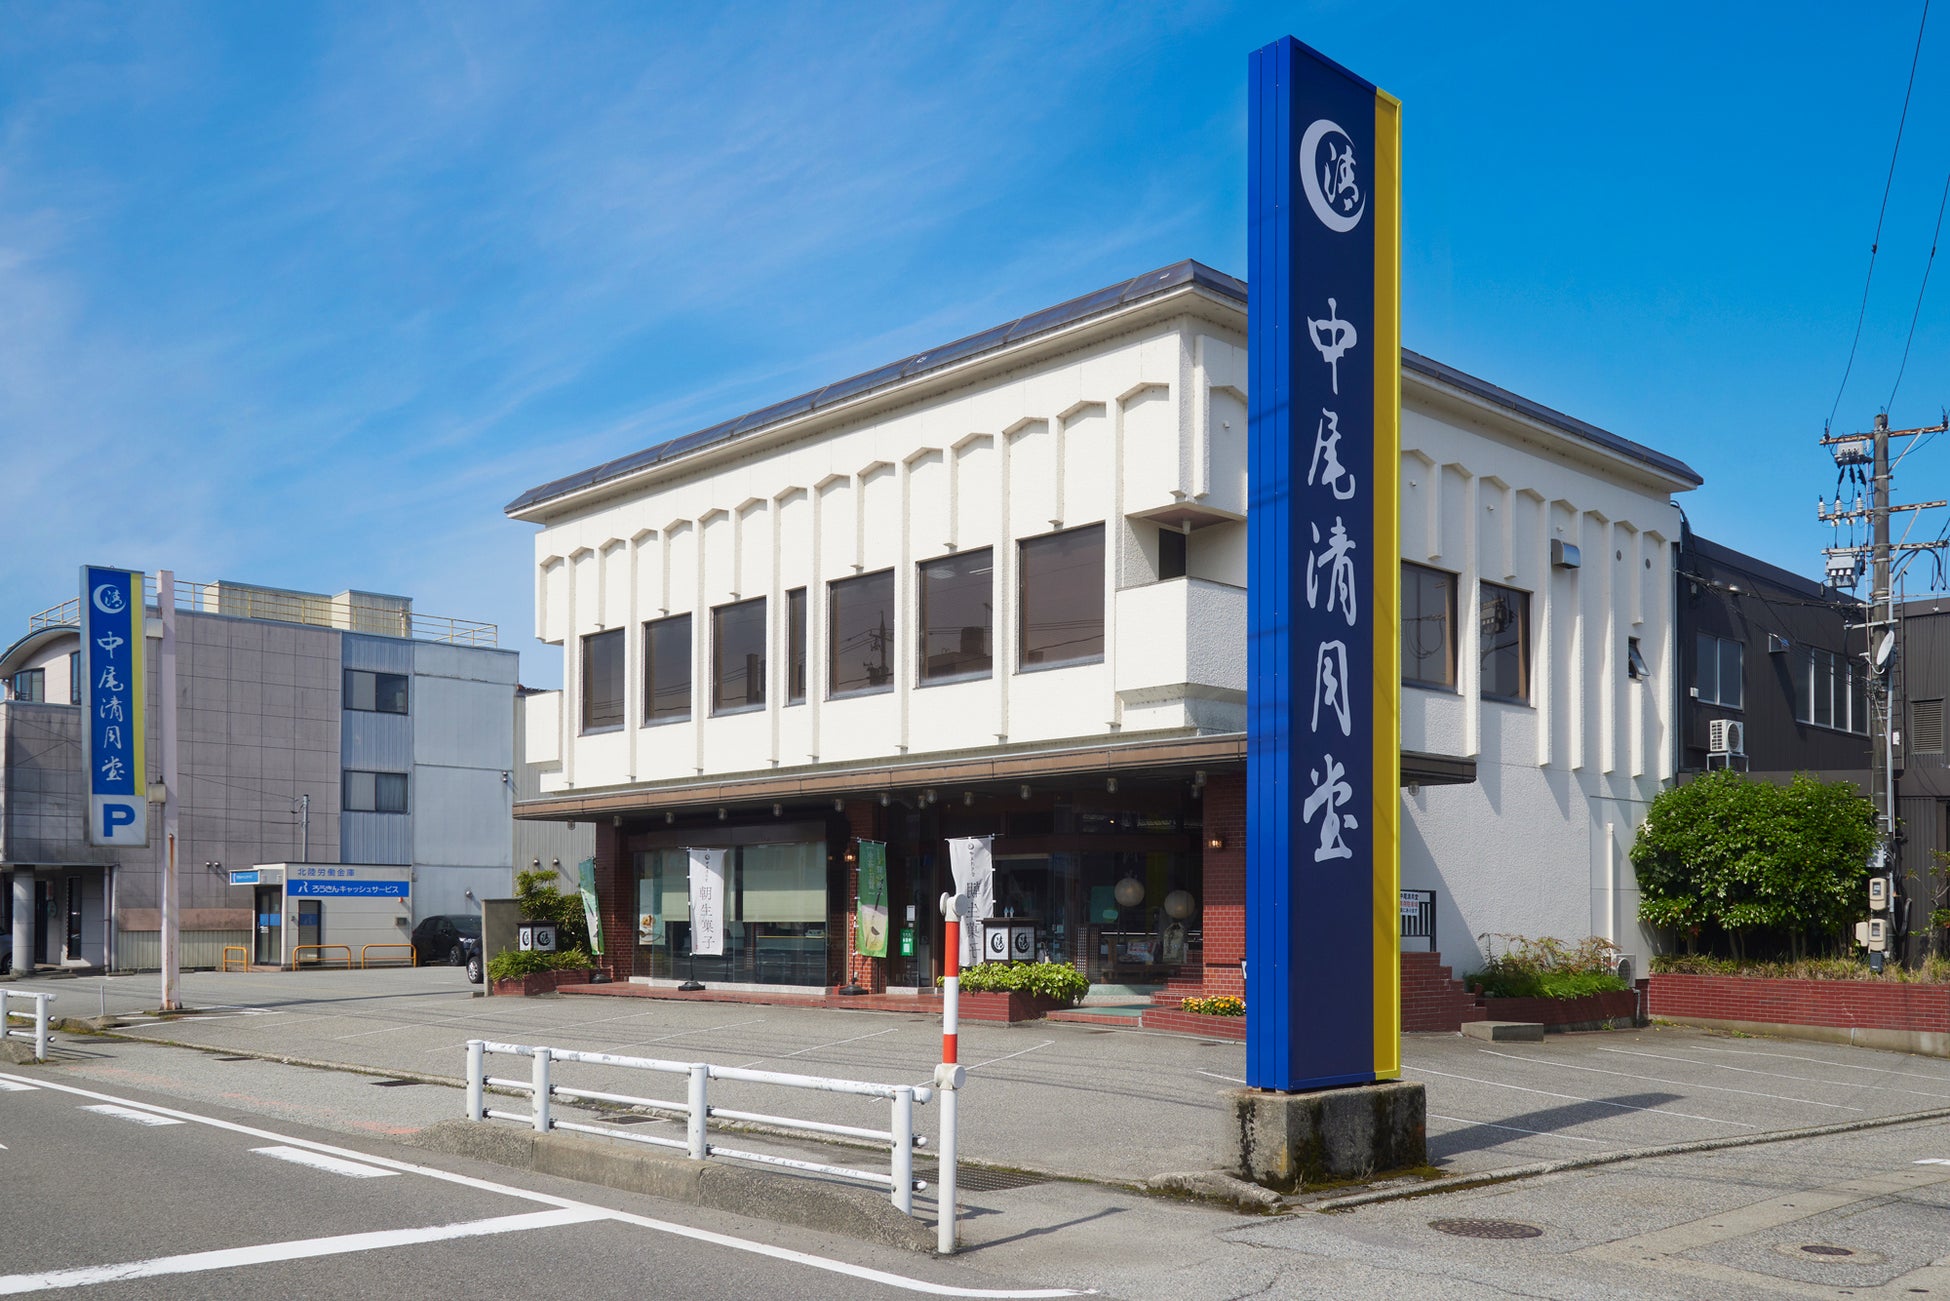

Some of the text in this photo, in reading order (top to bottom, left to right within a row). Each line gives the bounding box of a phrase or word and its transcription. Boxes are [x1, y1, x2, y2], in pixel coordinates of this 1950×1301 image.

[1303, 297, 1358, 862] 中尾清月堂
[97, 631, 125, 781] 中尾清月堂
[103, 803, 135, 837] P
[298, 867, 355, 877] 北陸労働金庫
[312, 884, 399, 894] ろうきんキャッシュサービス
[699, 886, 715, 949] 朝生菓子
